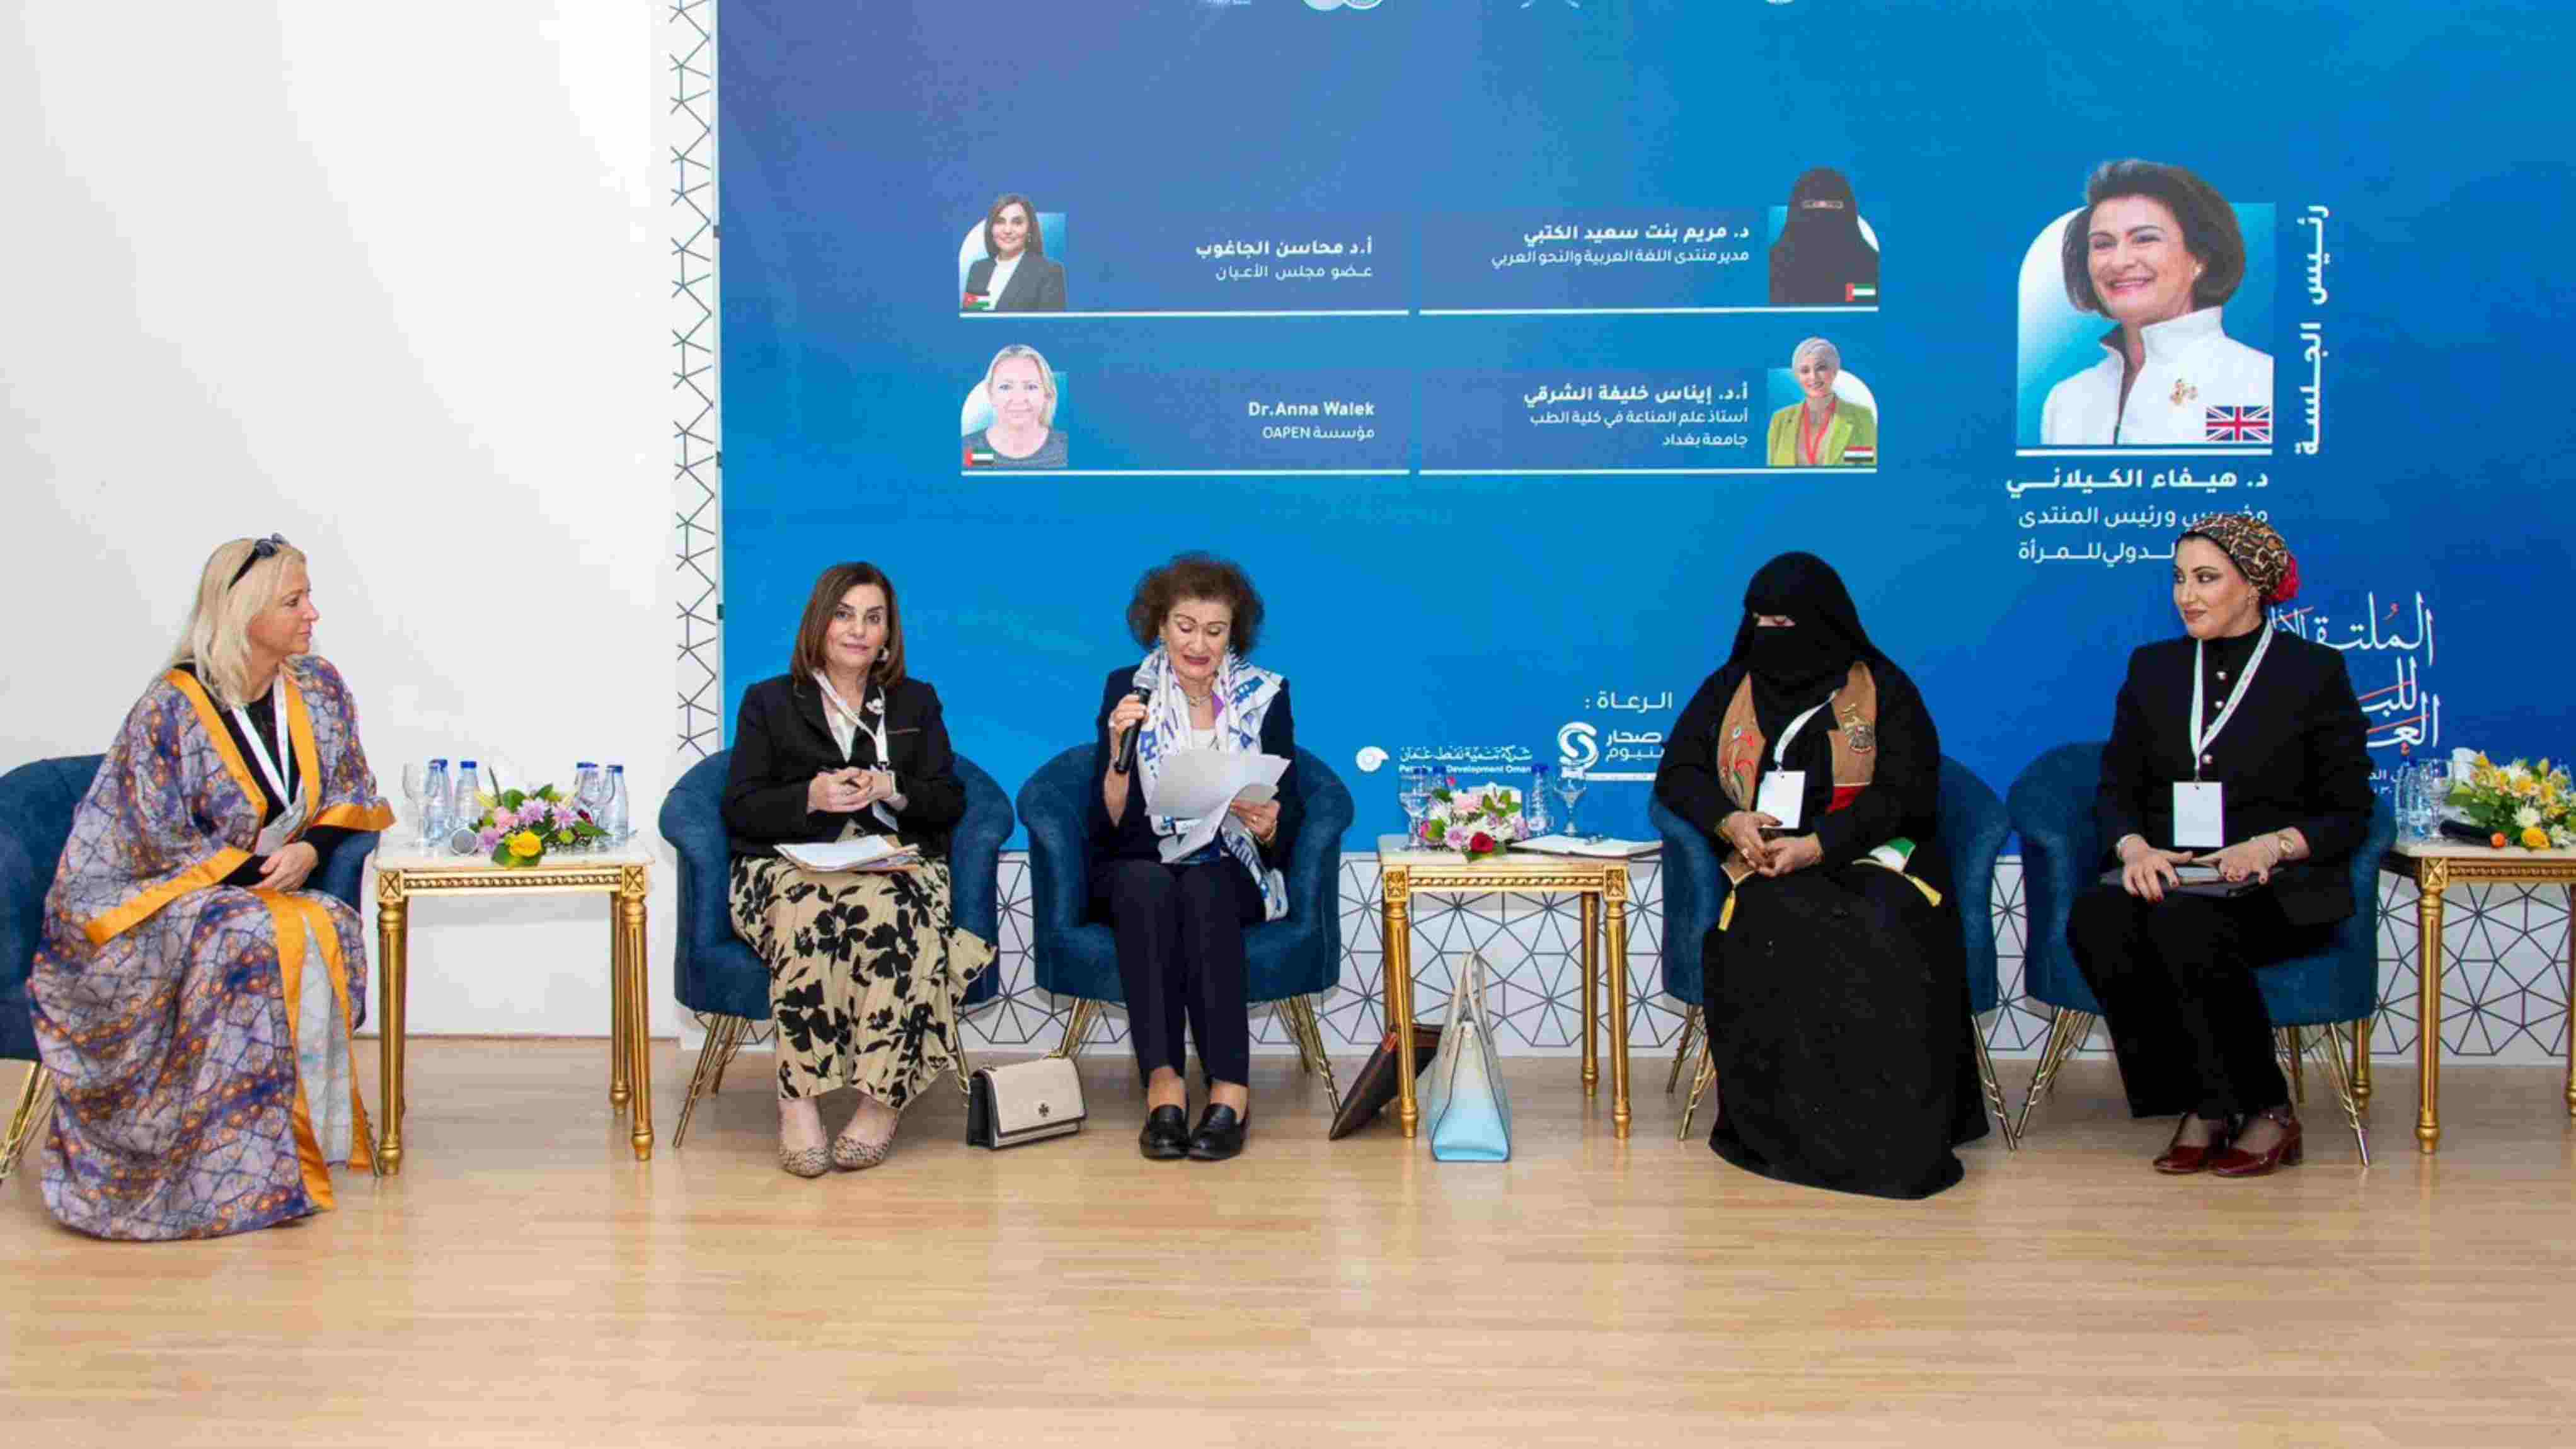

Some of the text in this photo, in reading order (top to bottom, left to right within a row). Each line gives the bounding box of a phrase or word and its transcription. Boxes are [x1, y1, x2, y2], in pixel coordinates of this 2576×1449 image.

[1524, 224, 1749, 246] د. مريم بنت سعيد الكتبي
[1195, 235, 1372, 259] أ.د محاسن الجاغوب
[1492, 248, 1749, 269] مدير منتدى اللغة العربية والنحو العربي
[1216, 263, 1372, 282] عضو مجلس الأعيان
[2294, 205, 2330, 455] رئيس الجلسة
[1524, 383, 1593, 408] الشرقي
[1598, 384, 1649, 404] خليفة
[1655, 386, 1712, 405] إيناس
[1323, 401, 1376, 416] Walek
[1529, 408, 1748, 428] أستاذ علم المناعة في كلية الطب
[1263, 425, 1376, 441] مؤسسة OAPEN
[1662, 433, 1748, 450] جامعة بغداد
[2006, 467, 2268, 498] د. هيفاء الكيلاني
[2018, 506, 2098, 528] المنتدى
[2105, 506, 2176, 528] ورئيس
[2018, 539, 2176, 567] لدولي للمرأة
[1597, 690, 1673, 714] الرعاة
[1606, 730, 1663, 747] صحار
[1446, 764, 1532, 774] Development Oman
